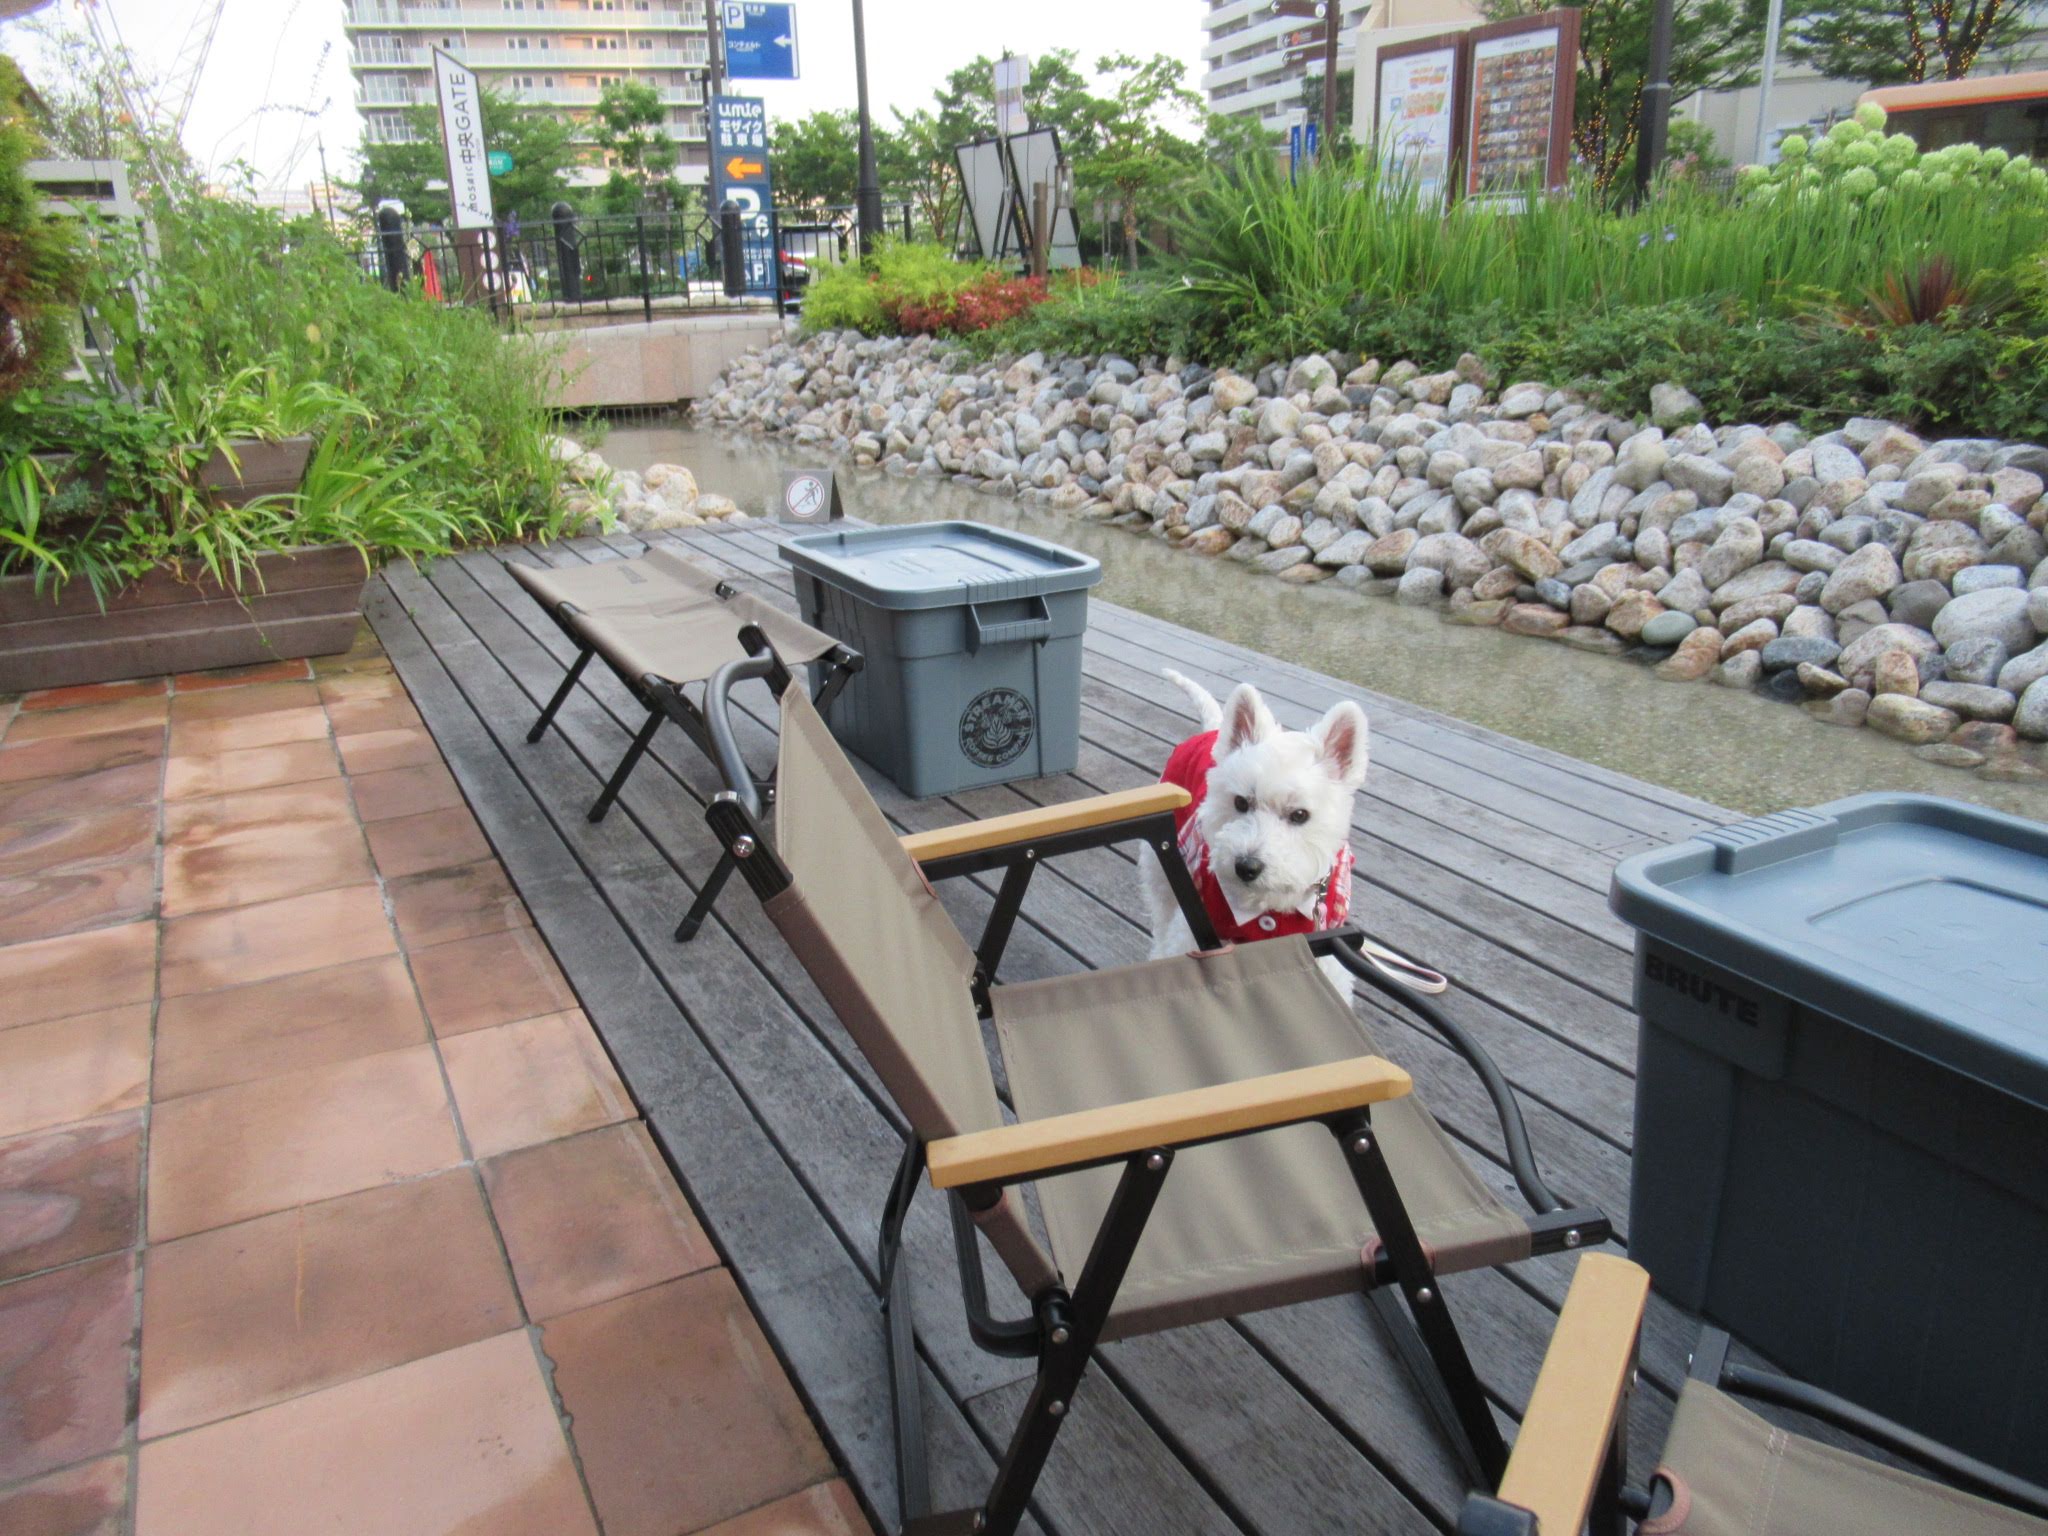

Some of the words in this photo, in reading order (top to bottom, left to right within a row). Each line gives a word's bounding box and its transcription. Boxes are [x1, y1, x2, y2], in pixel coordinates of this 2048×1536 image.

[728, 6, 740, 25] P
[719, 102, 761, 118] umie
[720, 120, 762, 133] モザイク
[964, 694, 1029, 732] STREAMER
[1645, 953, 1760, 1028] BRUTE
